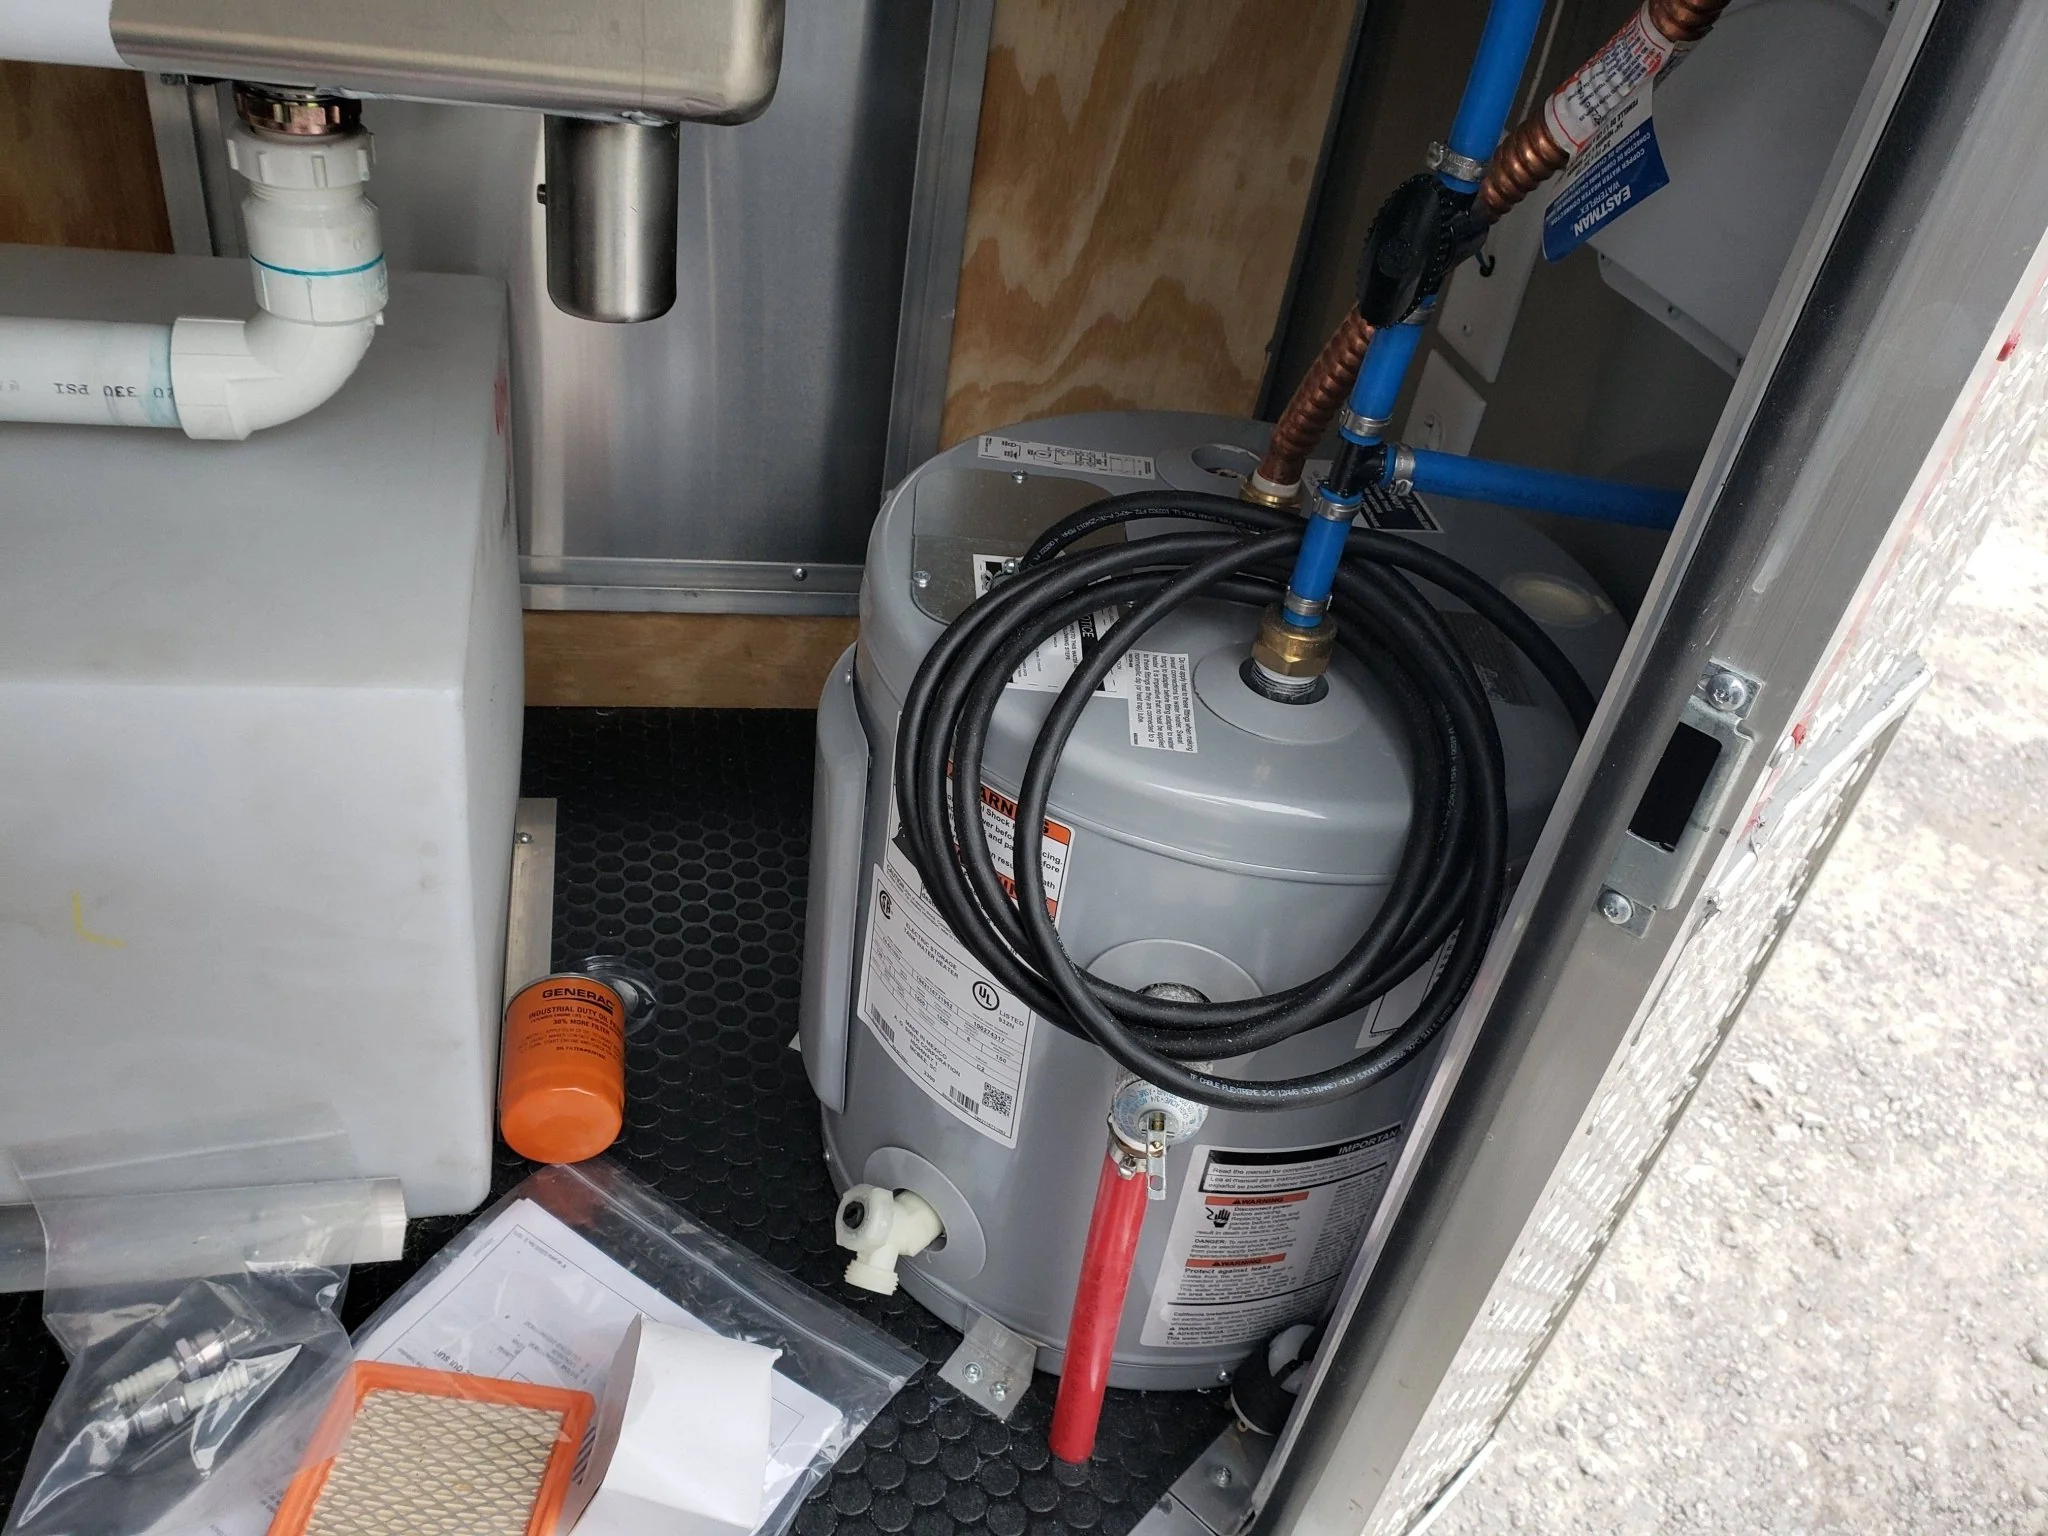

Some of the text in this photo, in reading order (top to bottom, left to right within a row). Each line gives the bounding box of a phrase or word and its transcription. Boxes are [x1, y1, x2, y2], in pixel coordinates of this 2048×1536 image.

[1620, 147, 1646, 169] COPPER
[1600, 165, 1622, 185] WATER
[1570, 184, 1634, 236] EASTMAN
[52, 382, 89, 395] PSI
[102, 384, 135, 397] 330
[1170, 669, 1178, 695] connections
[1178, 670, 1186, 681] apply
[985, 807, 1011, 827] Shock
[987, 831, 1003, 845] and
[902, 927, 917, 943] TANK
[915, 940, 936, 961] WATER
[934, 957, 960, 979] HEATER
[904, 922, 930, 948] ELECTRIC
[929, 944, 958, 970] STORAGE
[543, 987, 615, 1009] GENERAC
[977, 985, 991, 1006] UL
[529, 1007, 573, 1018] INDUSTRIAL
[577, 1006, 597, 1016] DUTY
[997, 1009, 1025, 1027] LISTED
[591, 1023, 610, 1035] FILTER
[904, 1019, 920, 1035] MADE
[919, 1033, 927, 1041] IN
[925, 1038, 948, 1060] MEXICO
[903, 1026, 921, 1043] SMITH
[919, 1041, 961, 1077] CORPORATION
[975, 1064, 986, 1072] C2
[1240, 1196, 1284, 1204] WARNING
[448, 1358, 463, 1372] QUI
